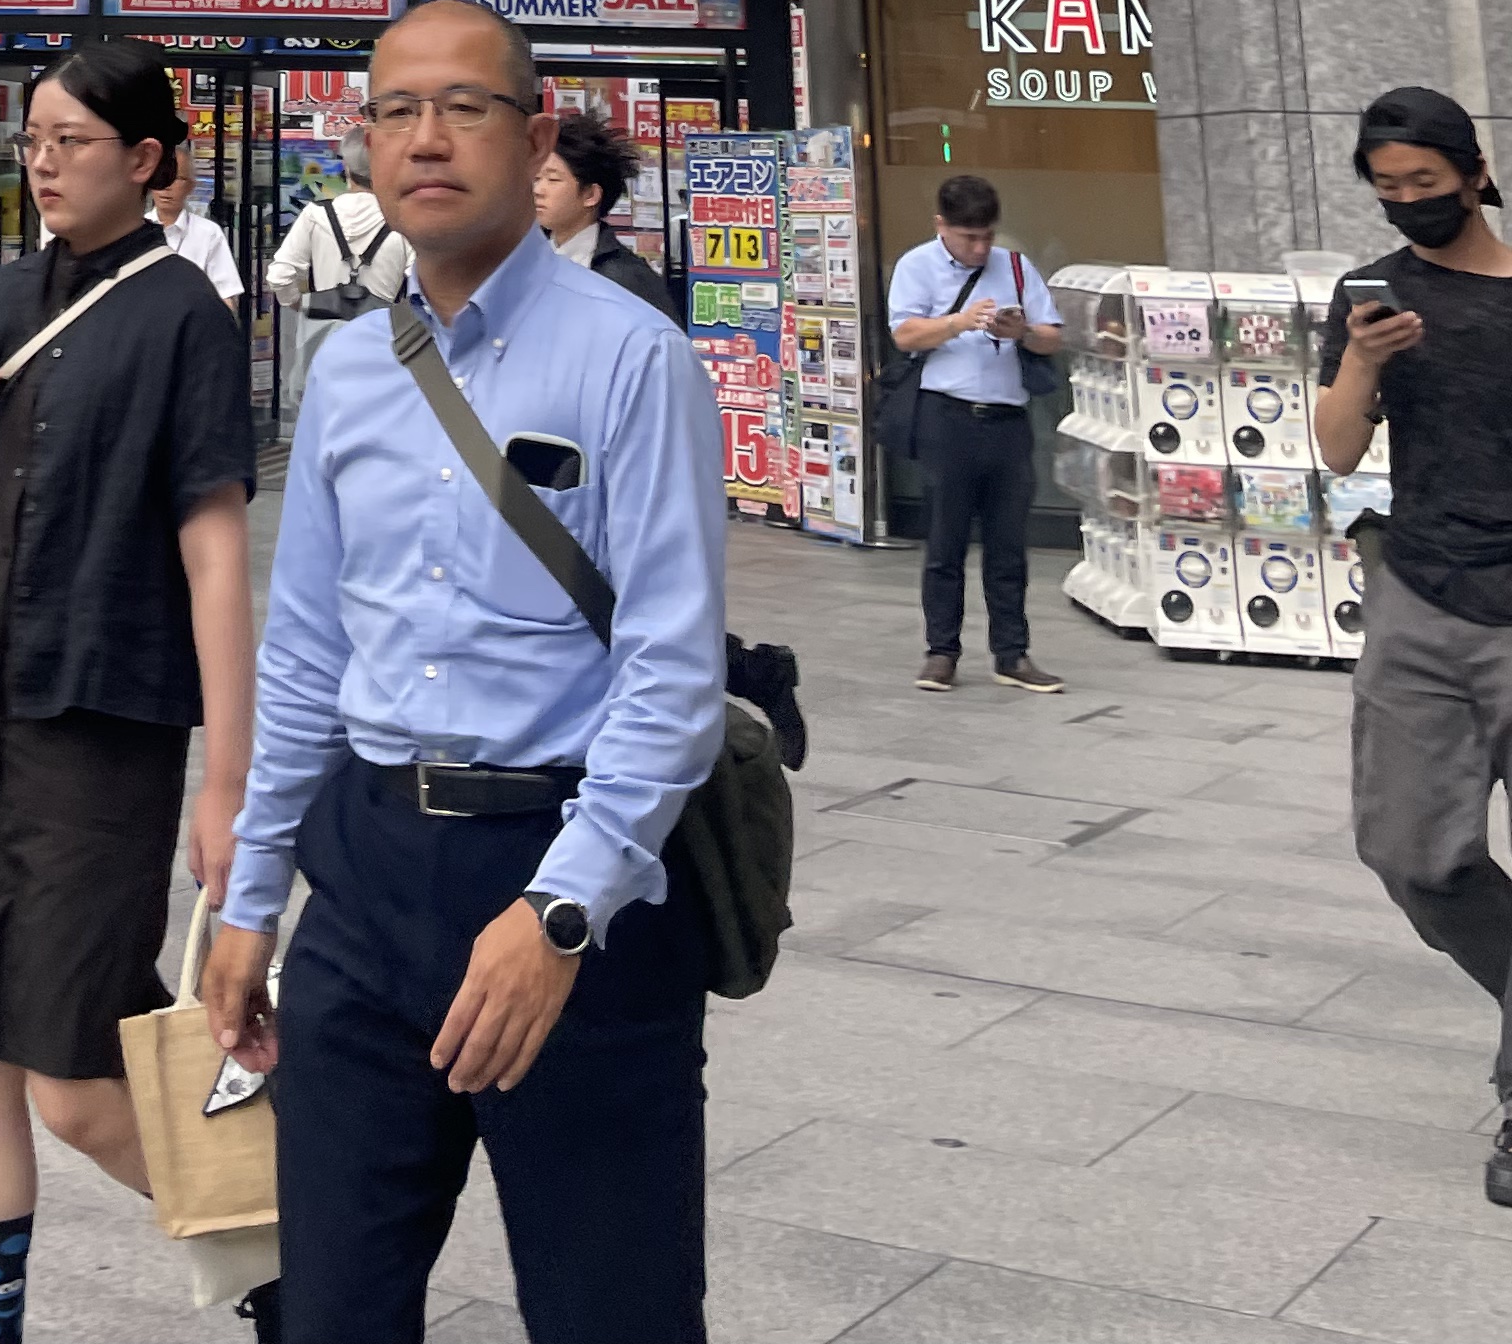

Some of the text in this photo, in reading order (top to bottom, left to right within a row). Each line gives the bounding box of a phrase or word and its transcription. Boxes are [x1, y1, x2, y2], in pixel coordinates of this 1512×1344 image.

[987, 68, 1114, 103] SOUP
[689, 158, 775, 194] エアコン
[707, 233, 723, 261] 7
[732, 233, 760, 262] 13
